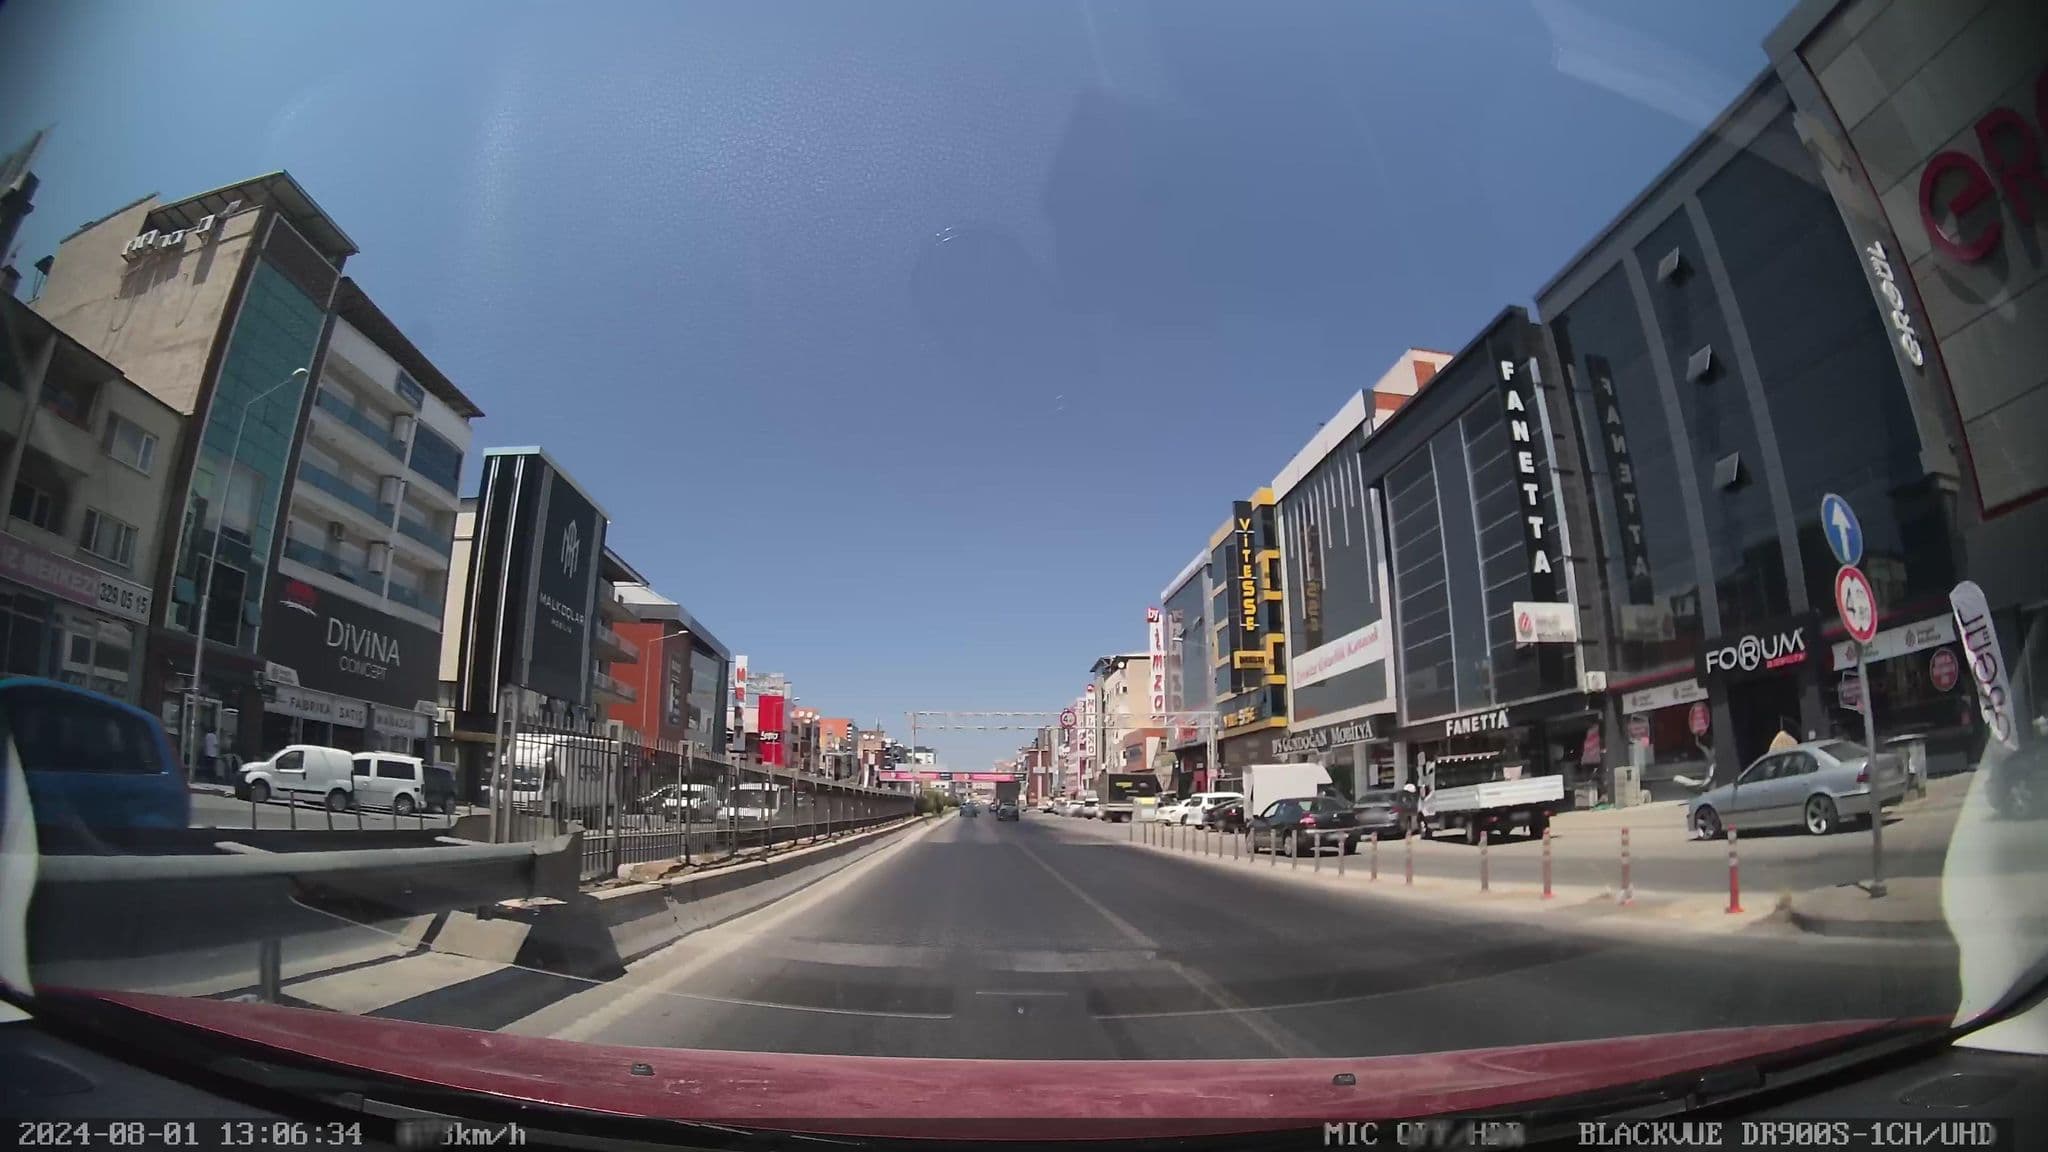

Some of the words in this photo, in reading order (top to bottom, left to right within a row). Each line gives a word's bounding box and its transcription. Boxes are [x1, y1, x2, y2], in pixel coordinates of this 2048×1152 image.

[1500, 360, 1552, 574] FANETTA
[338, 655, 388, 681] CONCEPT
[1705, 627, 1806, 675] FORUM
[1445, 709, 1510, 737] FANETTA
